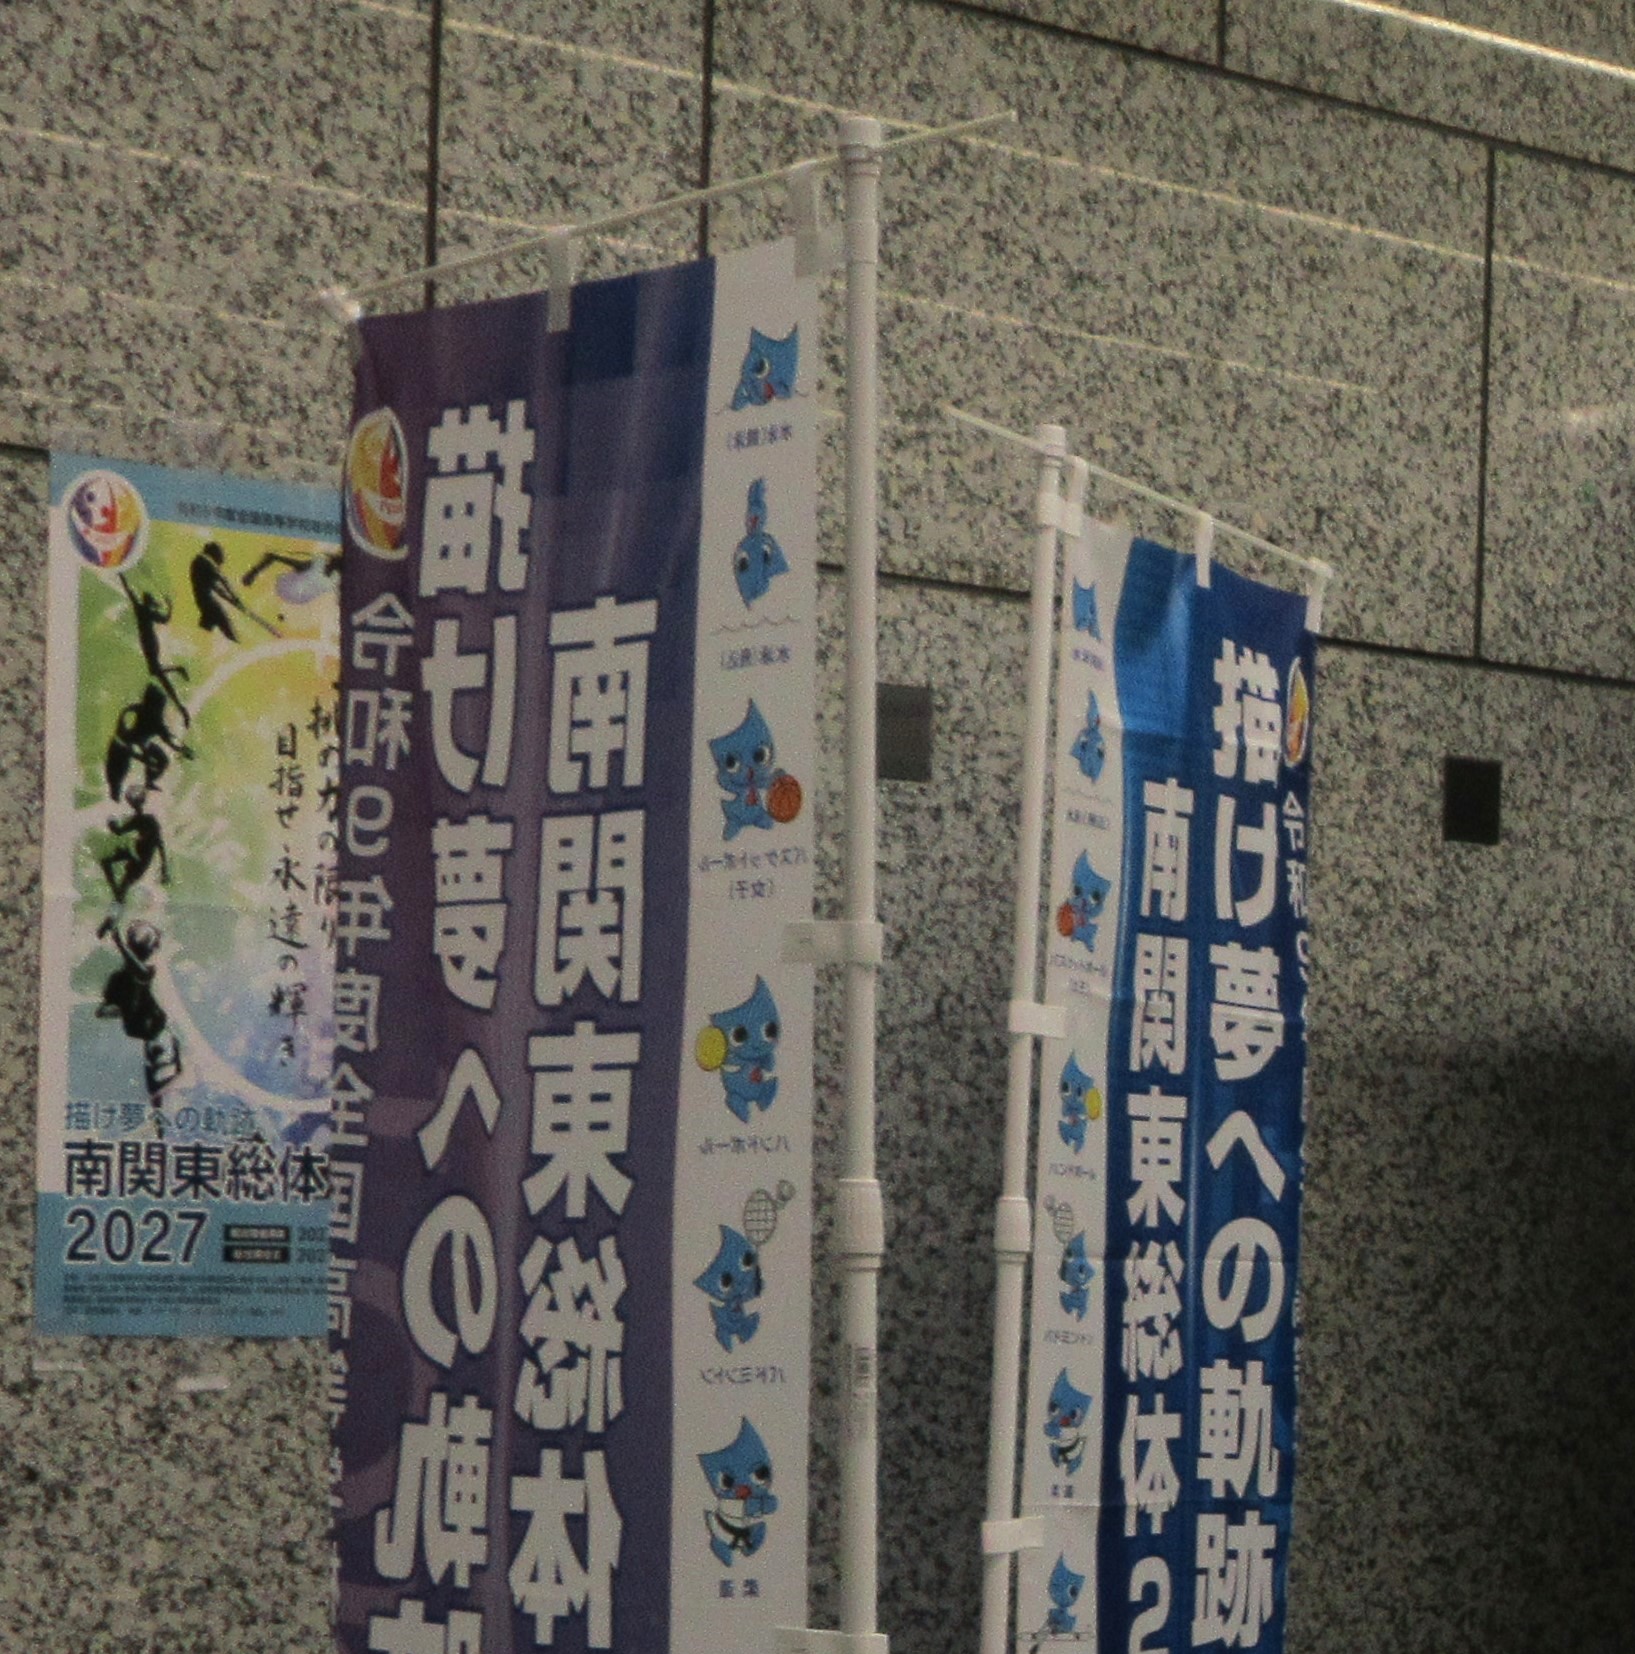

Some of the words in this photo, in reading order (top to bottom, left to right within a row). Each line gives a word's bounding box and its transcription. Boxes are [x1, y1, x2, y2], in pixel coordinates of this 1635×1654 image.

[64, 1138, 332, 1201] 南関東総体
[1190, 637, 1286, 1650] 描け夢への軌跡
[65, 1207, 208, 1264] 2027
